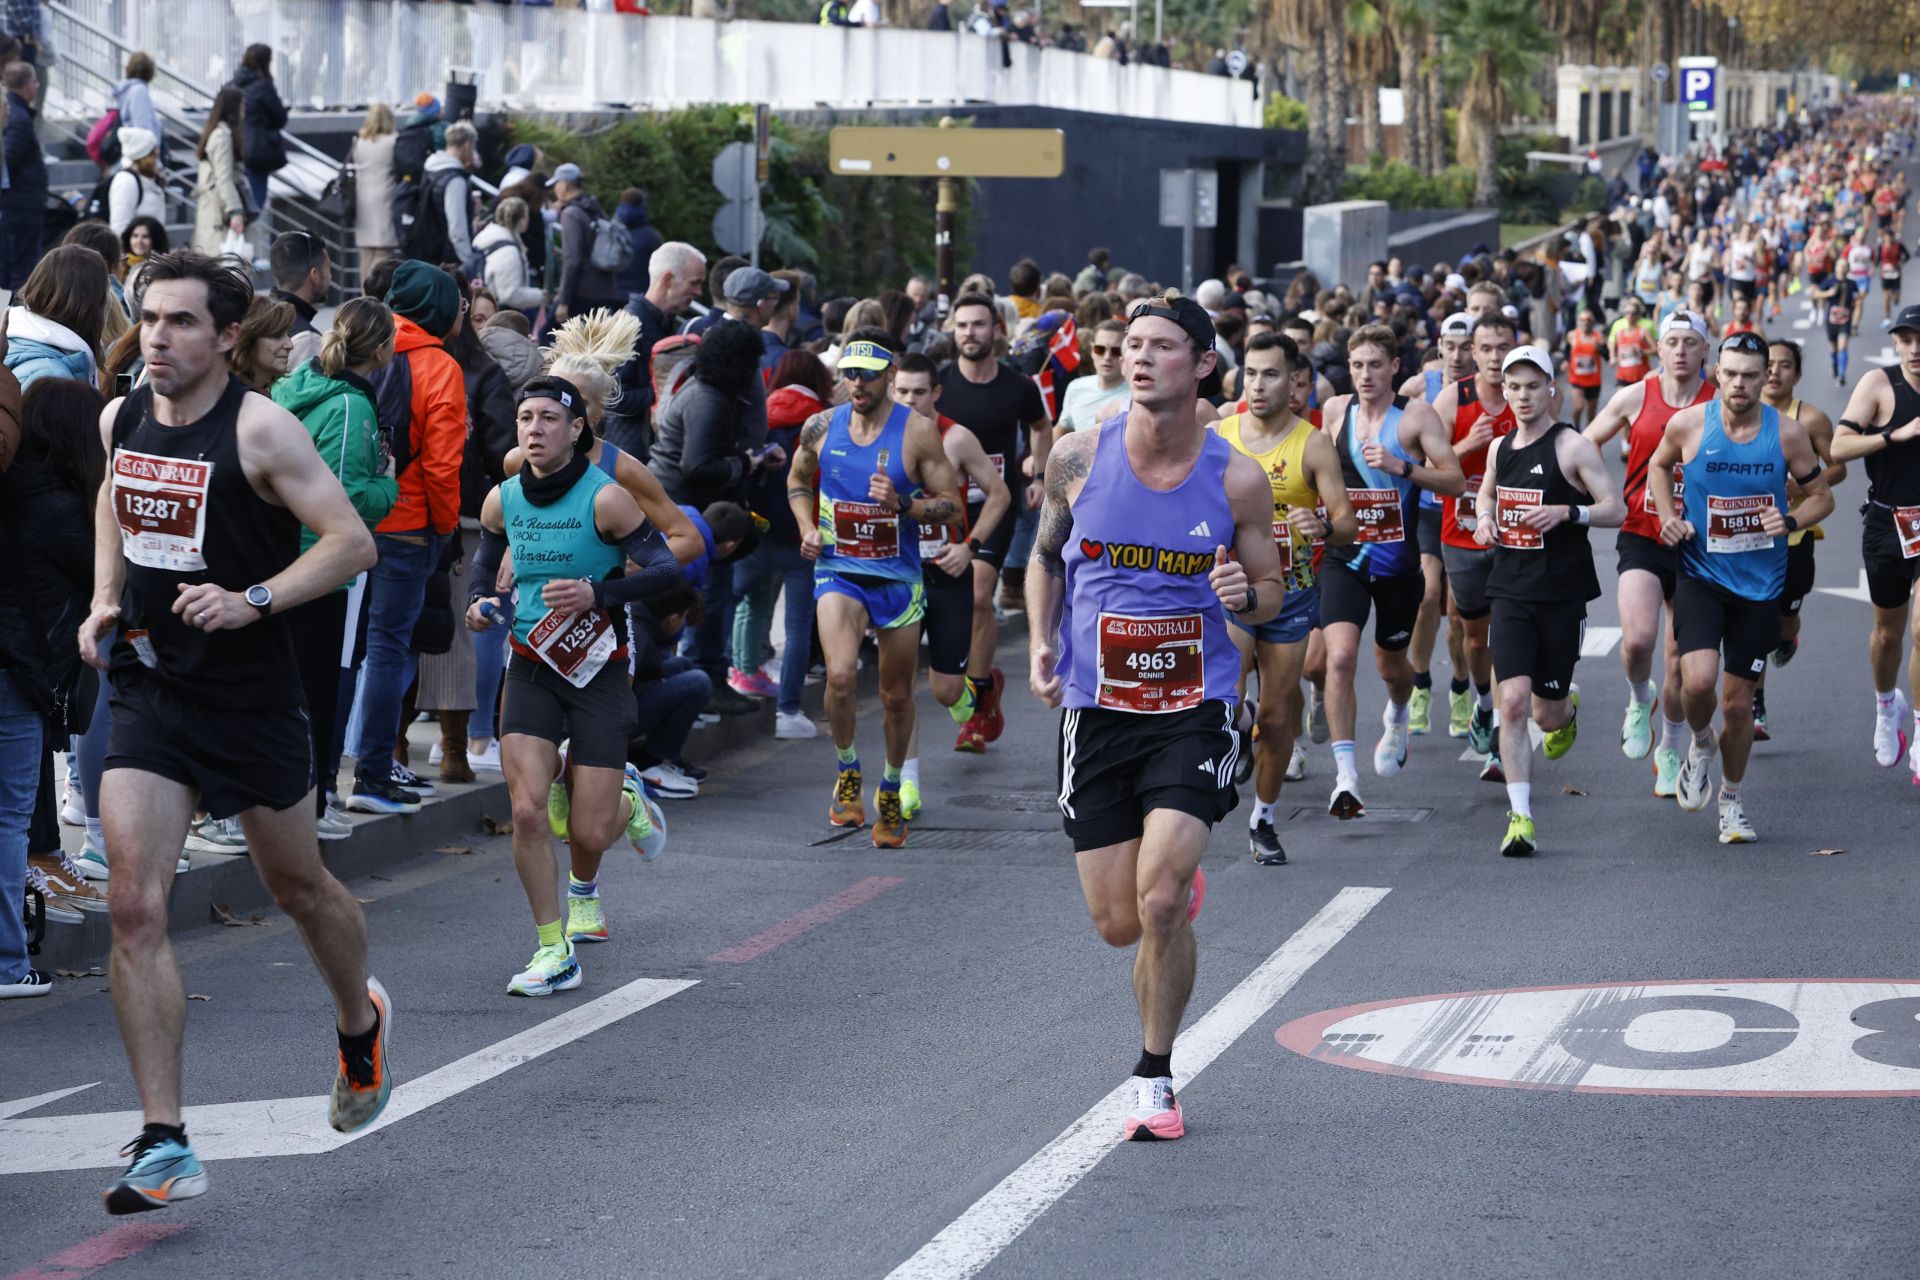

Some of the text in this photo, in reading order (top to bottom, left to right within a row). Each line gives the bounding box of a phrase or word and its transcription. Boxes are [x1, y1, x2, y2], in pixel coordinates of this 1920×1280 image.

[1687, 71, 1711, 100] P
[132, 460, 201, 483] GENERALI
[1705, 462, 1774, 475] SPARTA
[1354, 491, 1396, 500] GENERALI
[124, 494, 181, 520] 13287
[1724, 497, 1769, 510] GENERALI
[1355, 509, 1385, 520] 4639
[1721, 515, 1760, 529] 15816
[853, 522, 876, 535] 147
[514, 544, 574, 562] Sensitive
[1106, 542, 1215, 576] YOU MAMA
[558, 611, 601, 653] 12534
[1127, 620, 1196, 637] GENERALI
[1126, 652, 1176, 671] 4963
[1138, 671, 1165, 679] DENNIS
[1170, 688, 1189, 697] 42K
